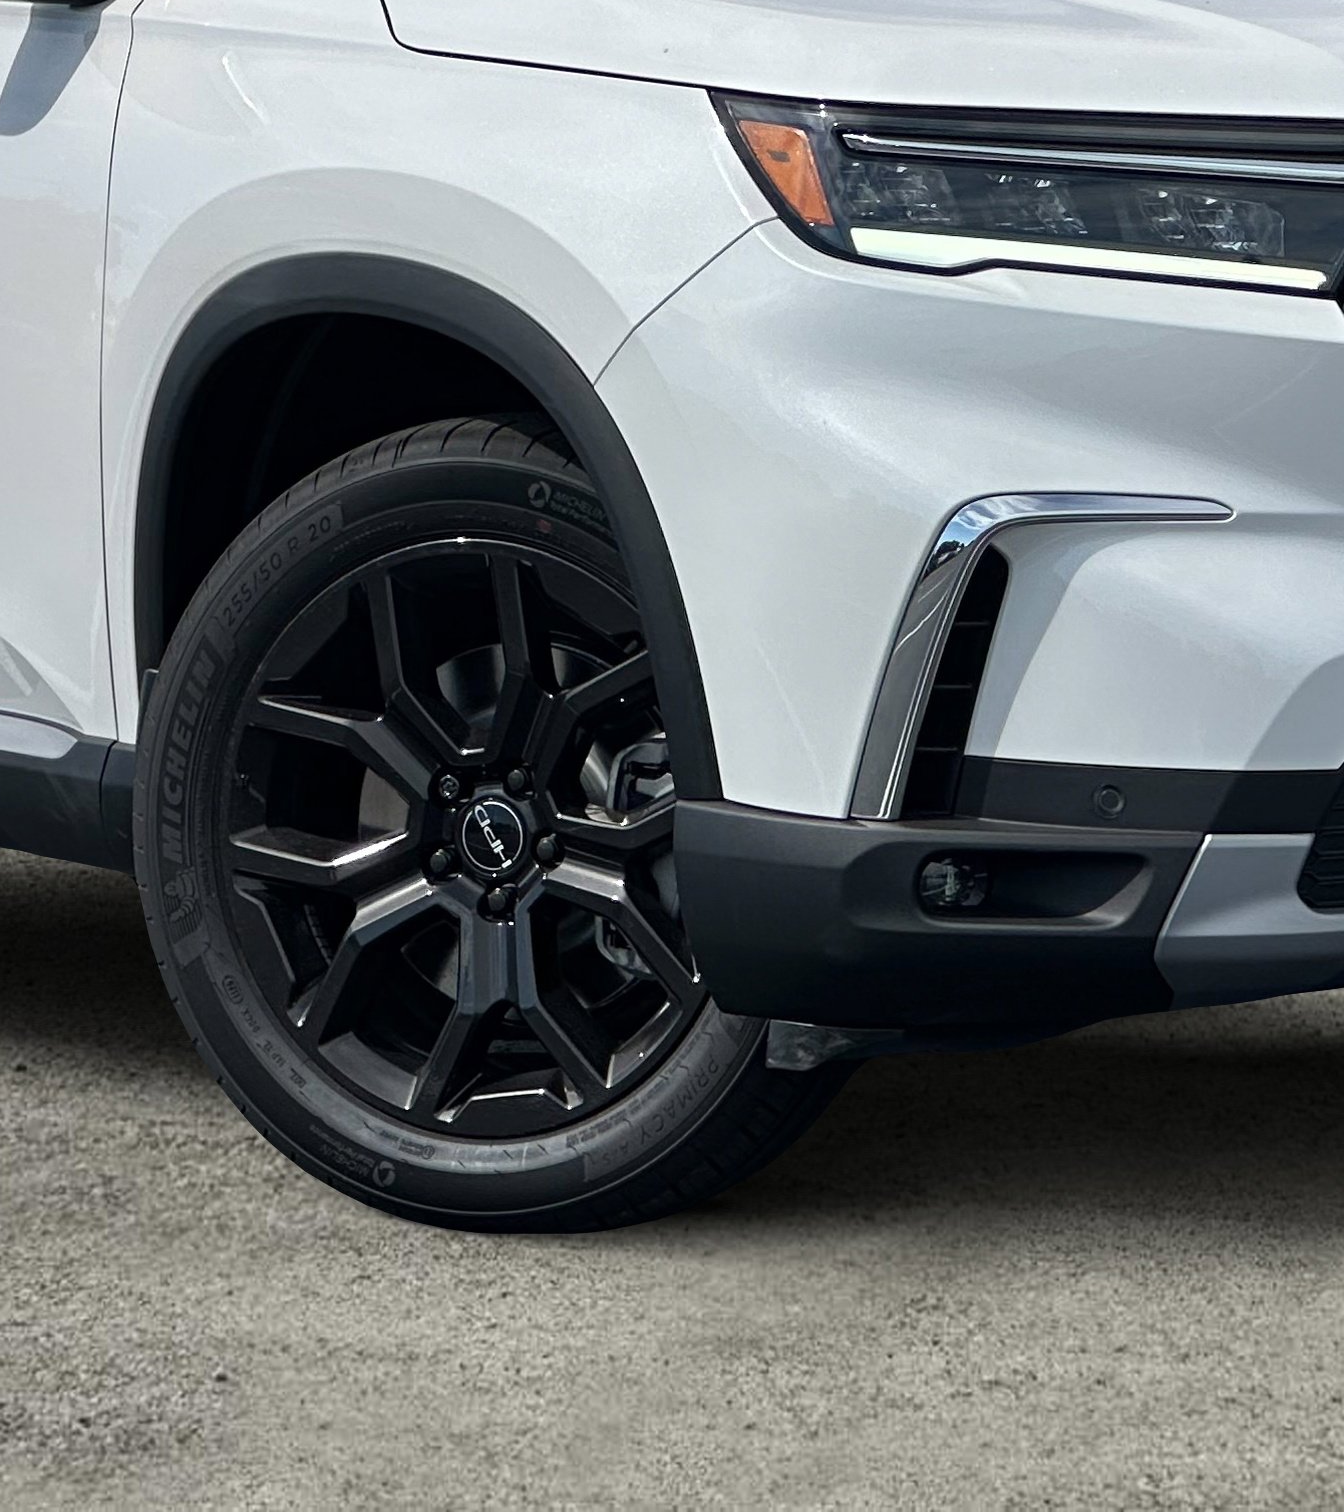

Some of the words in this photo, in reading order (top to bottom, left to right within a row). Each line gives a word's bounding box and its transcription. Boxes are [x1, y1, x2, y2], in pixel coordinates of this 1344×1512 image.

[223, 552, 282, 627] 255/50
[308, 515, 331, 542] 20
[160, 648, 218, 865] MICHELIN
[640, 1056, 719, 1145] PRIMACY
